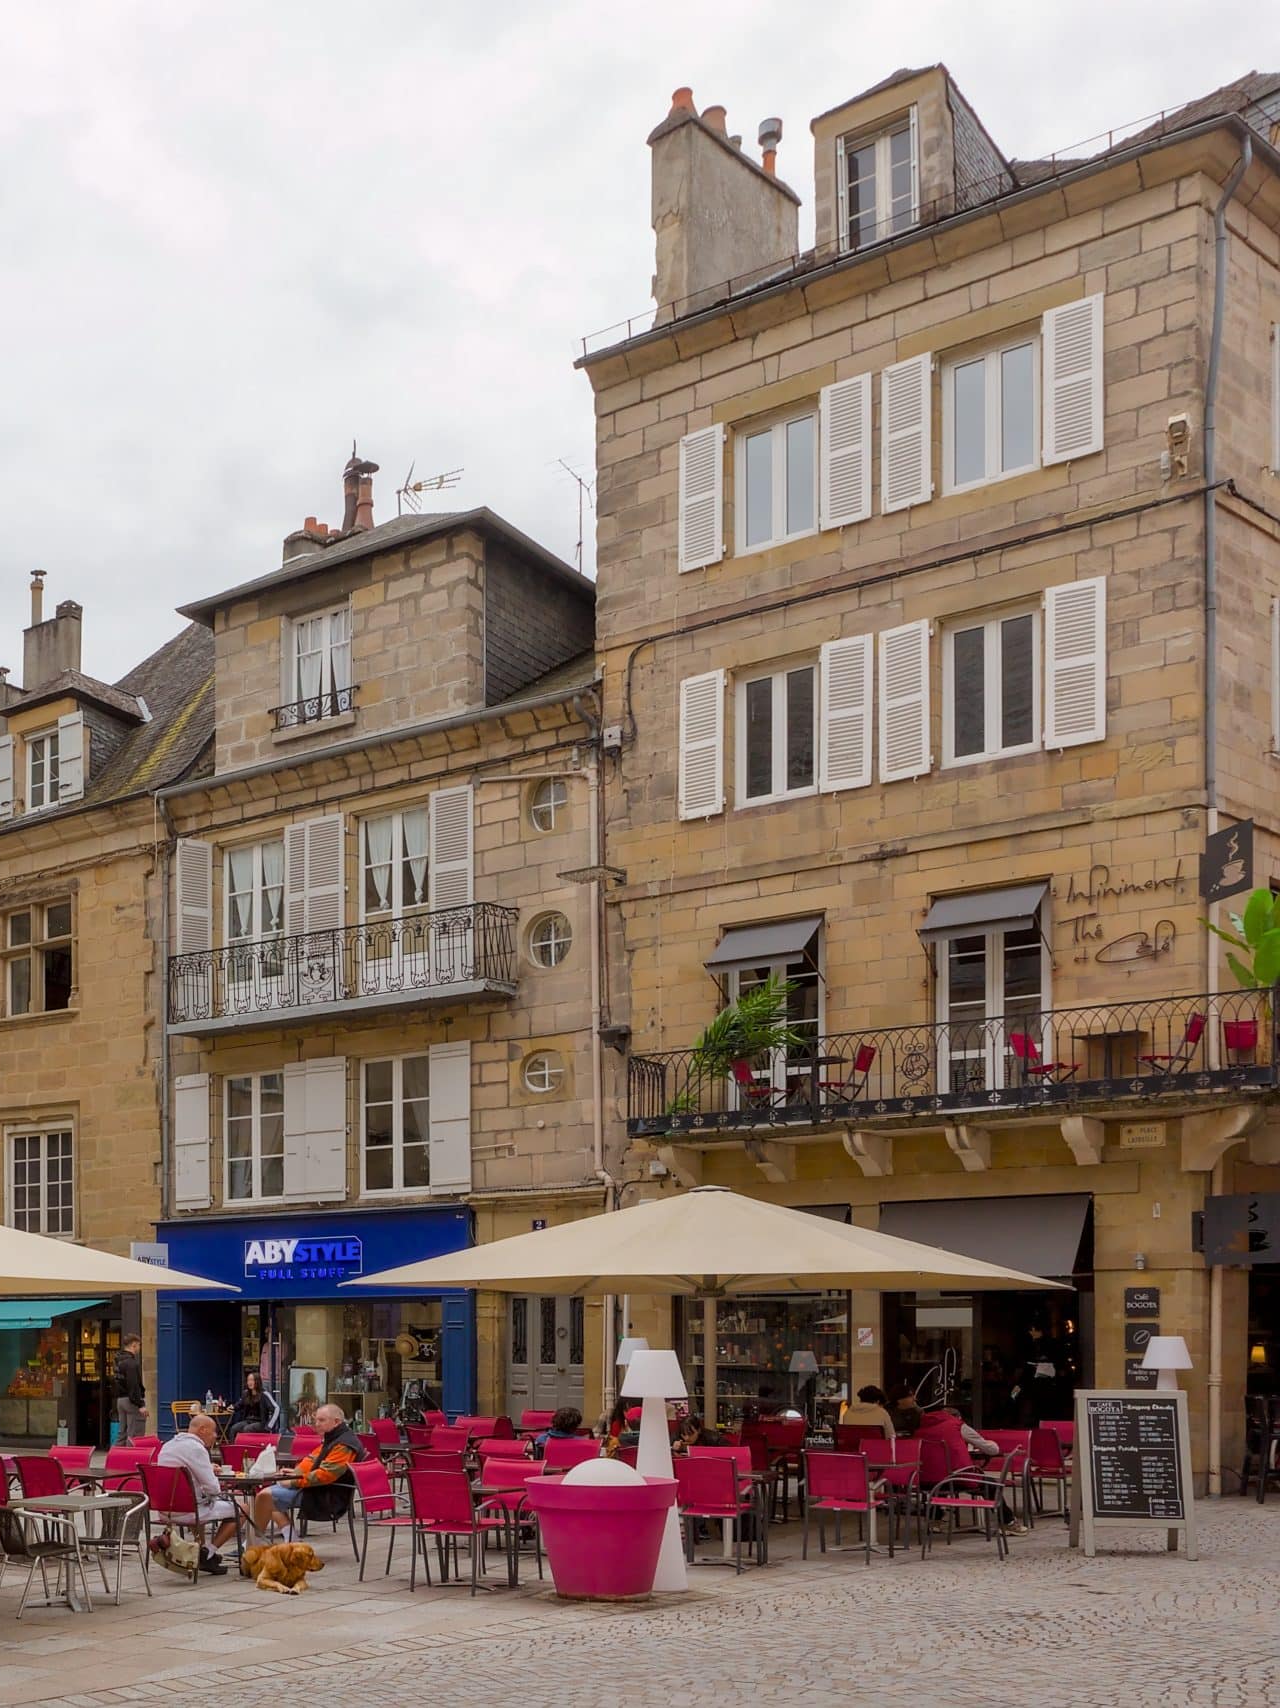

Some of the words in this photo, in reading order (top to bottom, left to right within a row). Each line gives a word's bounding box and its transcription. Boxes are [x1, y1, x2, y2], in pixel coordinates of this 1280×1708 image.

[1095, 919, 1176, 963] Café
[535, 1220, 543, 1230] 2
[245, 1239, 361, 1265] ABYSTYLE
[259, 1268, 294, 1280] FULL
[300, 1267, 345, 1279] STUFF
